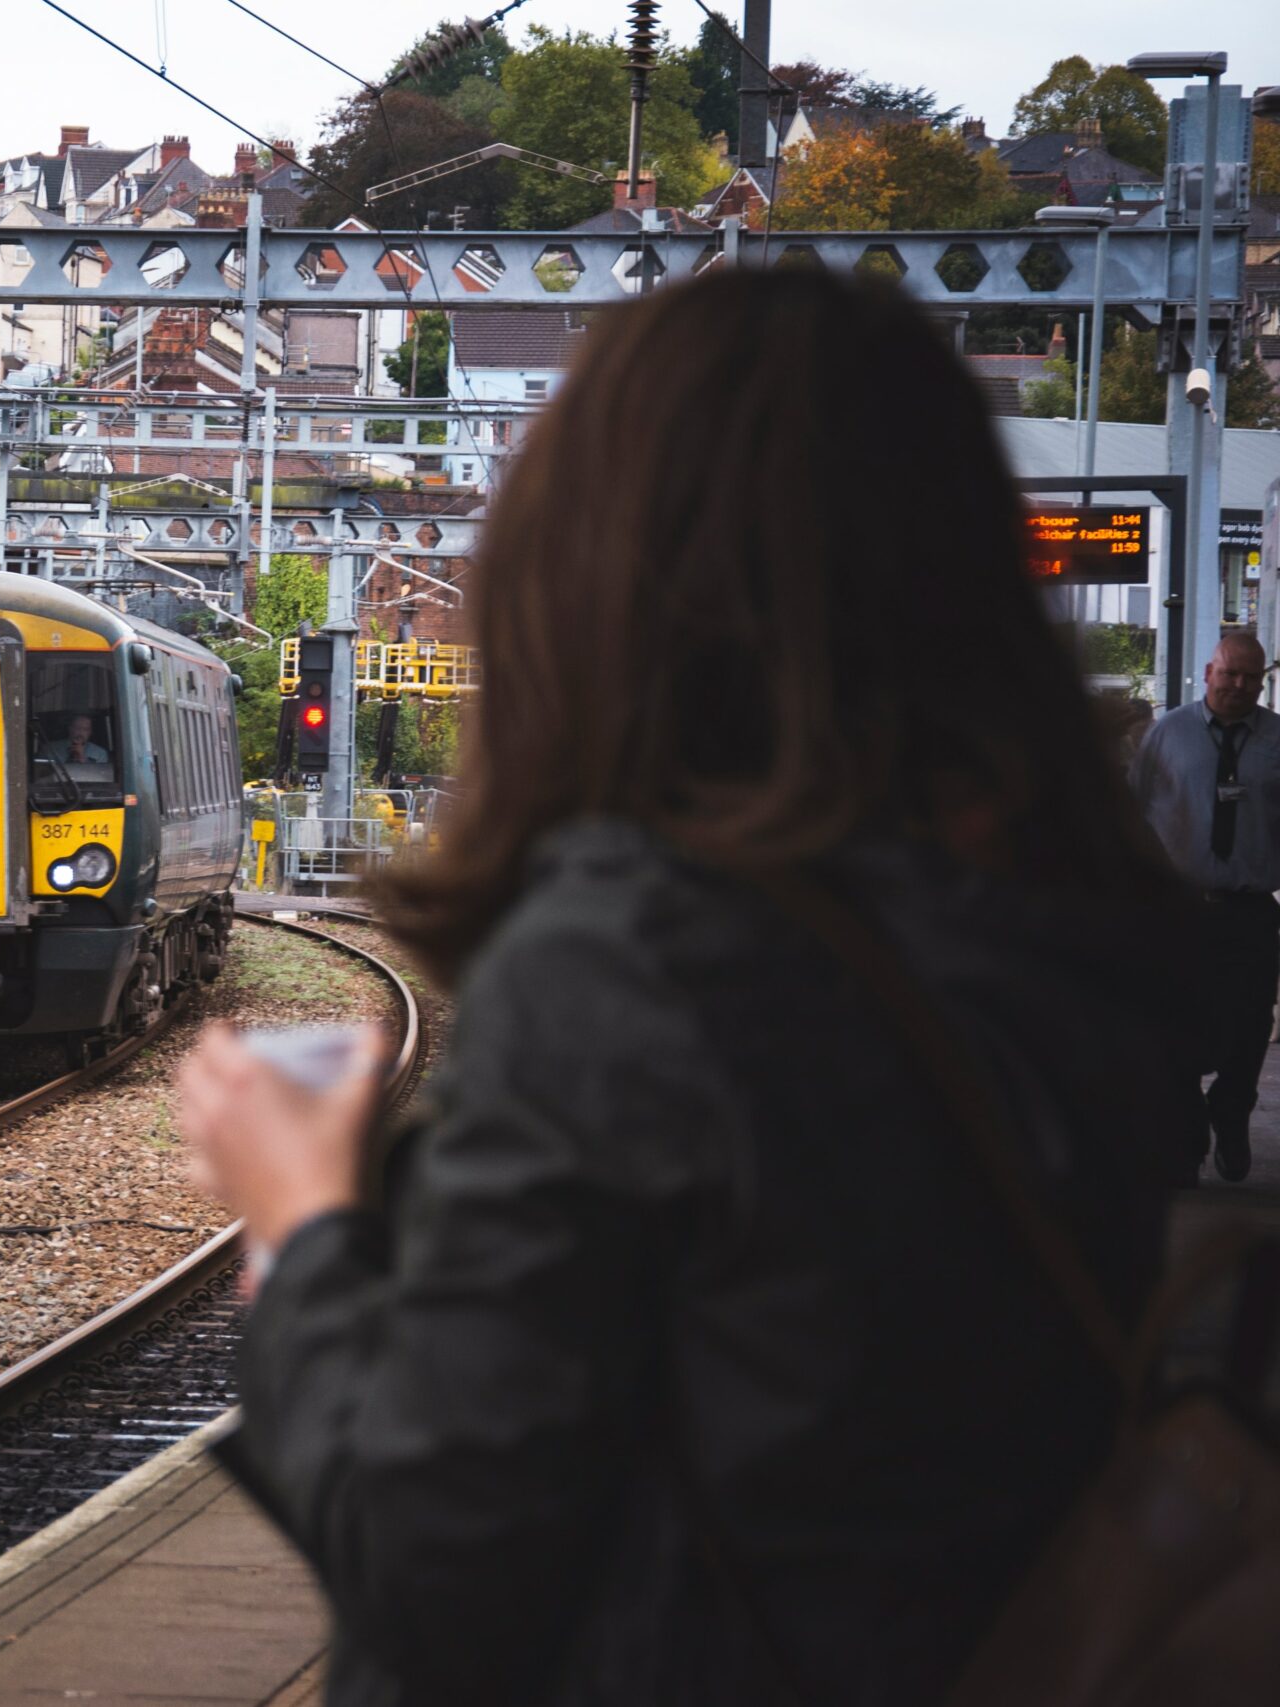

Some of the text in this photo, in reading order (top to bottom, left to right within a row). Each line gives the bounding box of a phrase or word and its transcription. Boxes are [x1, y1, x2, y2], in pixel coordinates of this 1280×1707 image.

[1112, 515, 1141, 525] 11:44
[1080, 529, 1129, 539] facilities
[1218, 536, 1230, 544] pen
[1111, 542, 1140, 553] 11:59
[41, 824, 109, 839] 387 144
